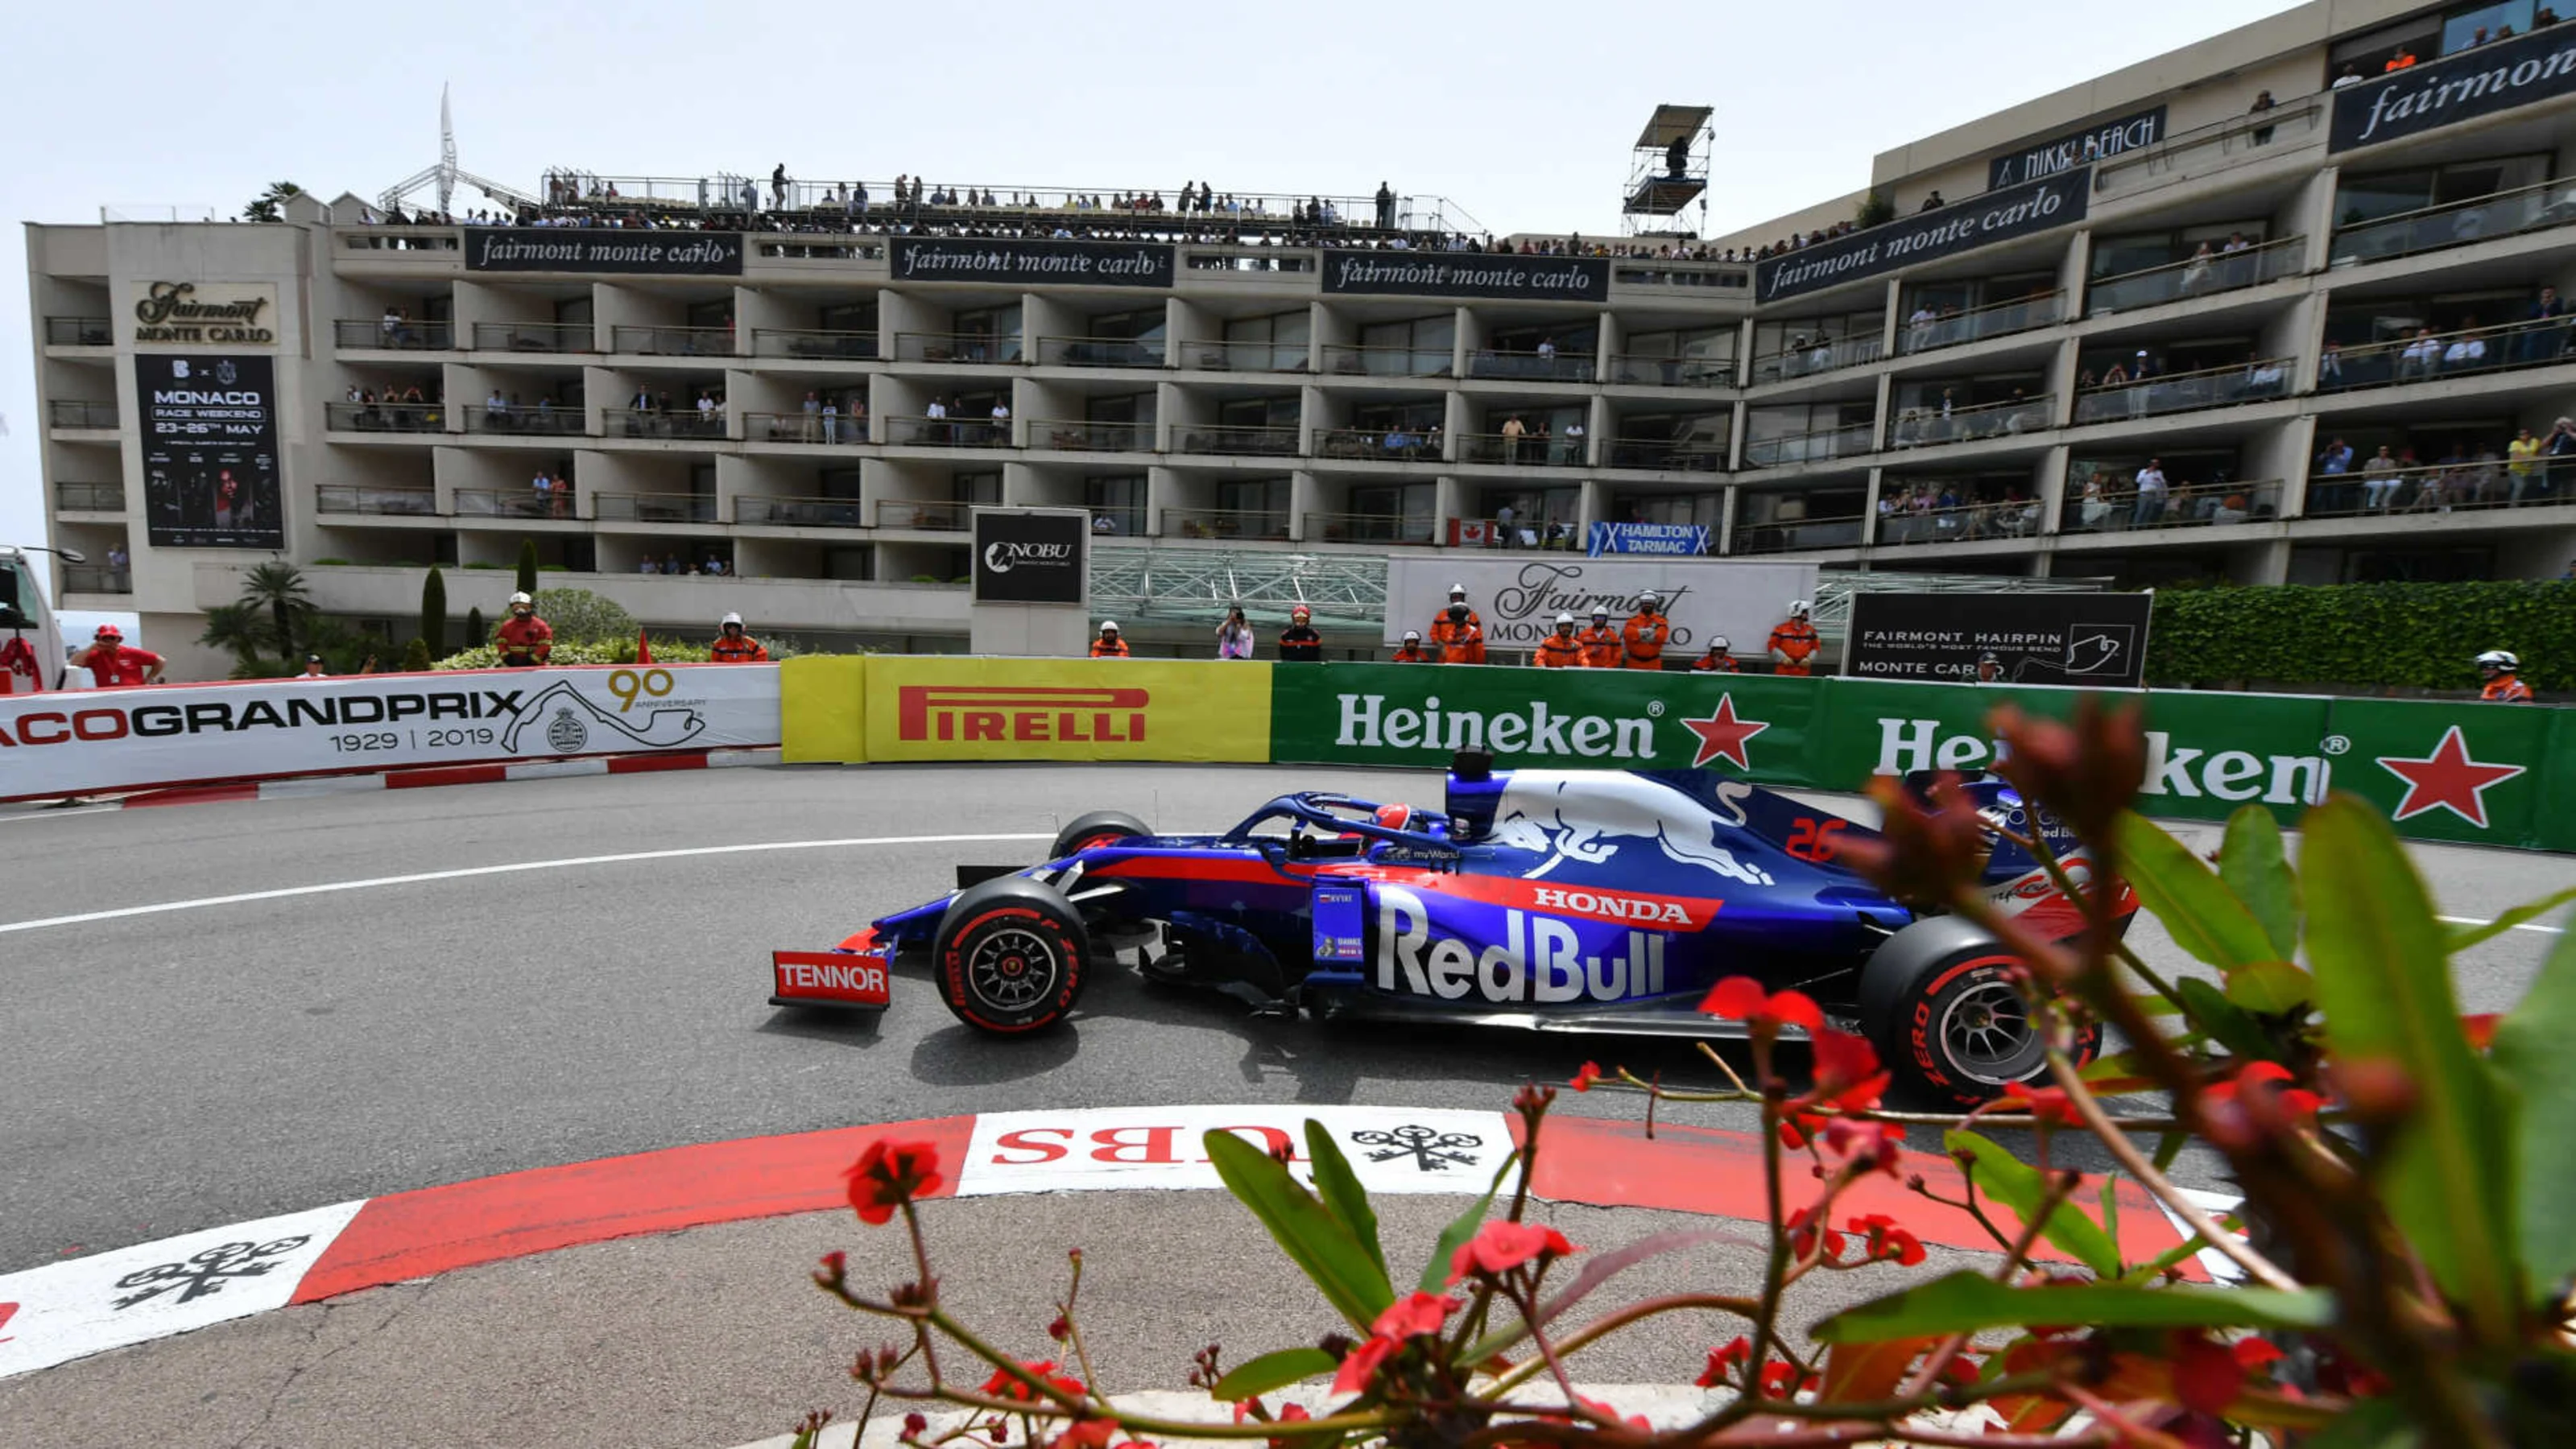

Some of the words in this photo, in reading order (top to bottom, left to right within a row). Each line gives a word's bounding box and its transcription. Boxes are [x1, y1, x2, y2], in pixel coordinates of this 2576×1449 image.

[2084, 114, 2156, 159] BEACH
[480, 235, 582, 266] fairmont
[588, 242, 662, 262] monte
[667, 239, 724, 263] carlo
[1768, 245, 1879, 297] fairmont
[1885, 217, 1974, 259] monte
[1982, 186, 2061, 230] carlo
[903, 245, 1012, 275] fairmont
[1018, 252, 1091, 273] monte
[1098, 250, 1156, 275] carlo
[1338, 256, 1444, 288] fairmont
[1451, 266, 1526, 287] monte
[1532, 264, 1590, 289] carlo
[135, 281, 268, 325] Fairmont
[136, 326, 201, 341] MONTE
[208, 327, 273, 343] CARLO
[154, 390, 261, 405] MONACO
[155, 409, 192, 418] RACE
[196, 410, 261, 419] WEEKEND
[225, 424, 263, 435] MAY
[1621, 524, 1693, 538] HAMILTON
[1627, 539, 1686, 553] TARMAC
[1007, 543, 1073, 558] NOBU
[1863, 630, 1964, 642] FAIRMONT
[1974, 632, 2062, 644] HAIRPIN
[1859, 661, 1929, 674] MONTE
[1934, 663, 2005, 675] CARO
[608, 667, 674, 712] 90
[899, 686, 1150, 742] PIRELLI
[1334, 692, 1657, 759] Heineken
[329, 732, 399, 753] 1929
[427, 728, 494, 748] 2019
[1872, 717, 2331, 807] Heken
[1784, 817, 1848, 863] 26
[1533, 887, 1693, 925] HONDA
[779, 964, 885, 993] TENNOR
[1912, 1001, 1950, 1087] ZERO
